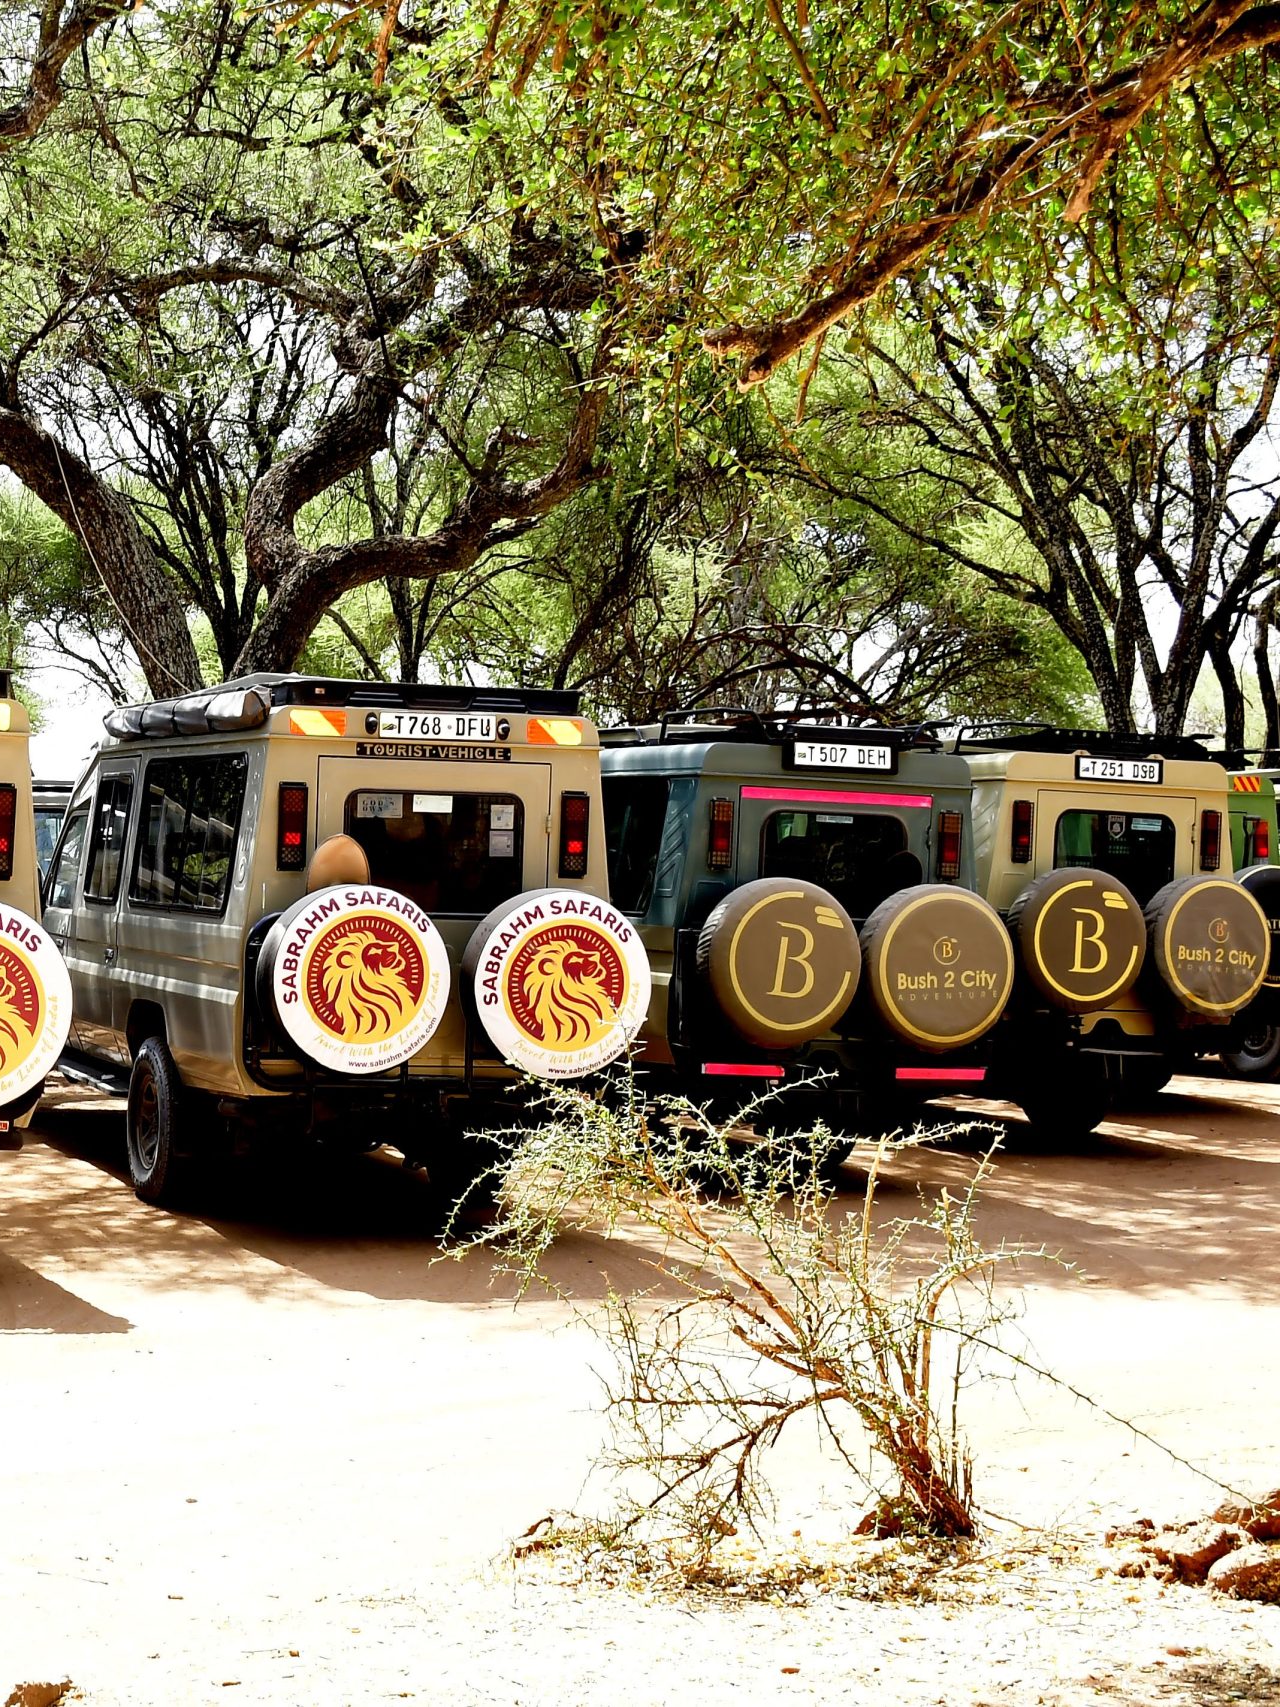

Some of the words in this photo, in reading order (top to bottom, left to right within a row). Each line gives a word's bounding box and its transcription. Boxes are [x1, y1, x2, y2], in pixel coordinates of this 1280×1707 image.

[395, 715, 404, 734] T
[408, 716, 441, 735] 768
[455, 717, 490, 737] DFU
[363, 743, 433, 758] TOURIST
[437, 746, 505, 760] VEHICLE
[808, 746, 815, 762] T
[819, 747, 847, 763] 507
[858, 748, 886, 765] DEH
[1090, 761, 1097, 775] T
[1101, 762, 1124, 777] 251
[1132, 764, 1155, 779] DSB
[281, 898, 341, 1005] SABRAHM
[345, 890, 431, 934] SAFARIS
[1068, 907, 1108, 974] B
[482, 905, 545, 1006] SABRAHM
[550, 899, 632, 943] SAFARIS
[765, 920, 815, 998] B
[1178, 945, 1211, 962] Bush
[1214, 948, 1224, 963] 2
[1228, 949, 1257, 969] City
[897, 972, 938, 990] Bush
[944, 971, 955, 988] 2
[960, 969, 997, 990] City
[898, 990, 998, 1001] ADVENTURE
